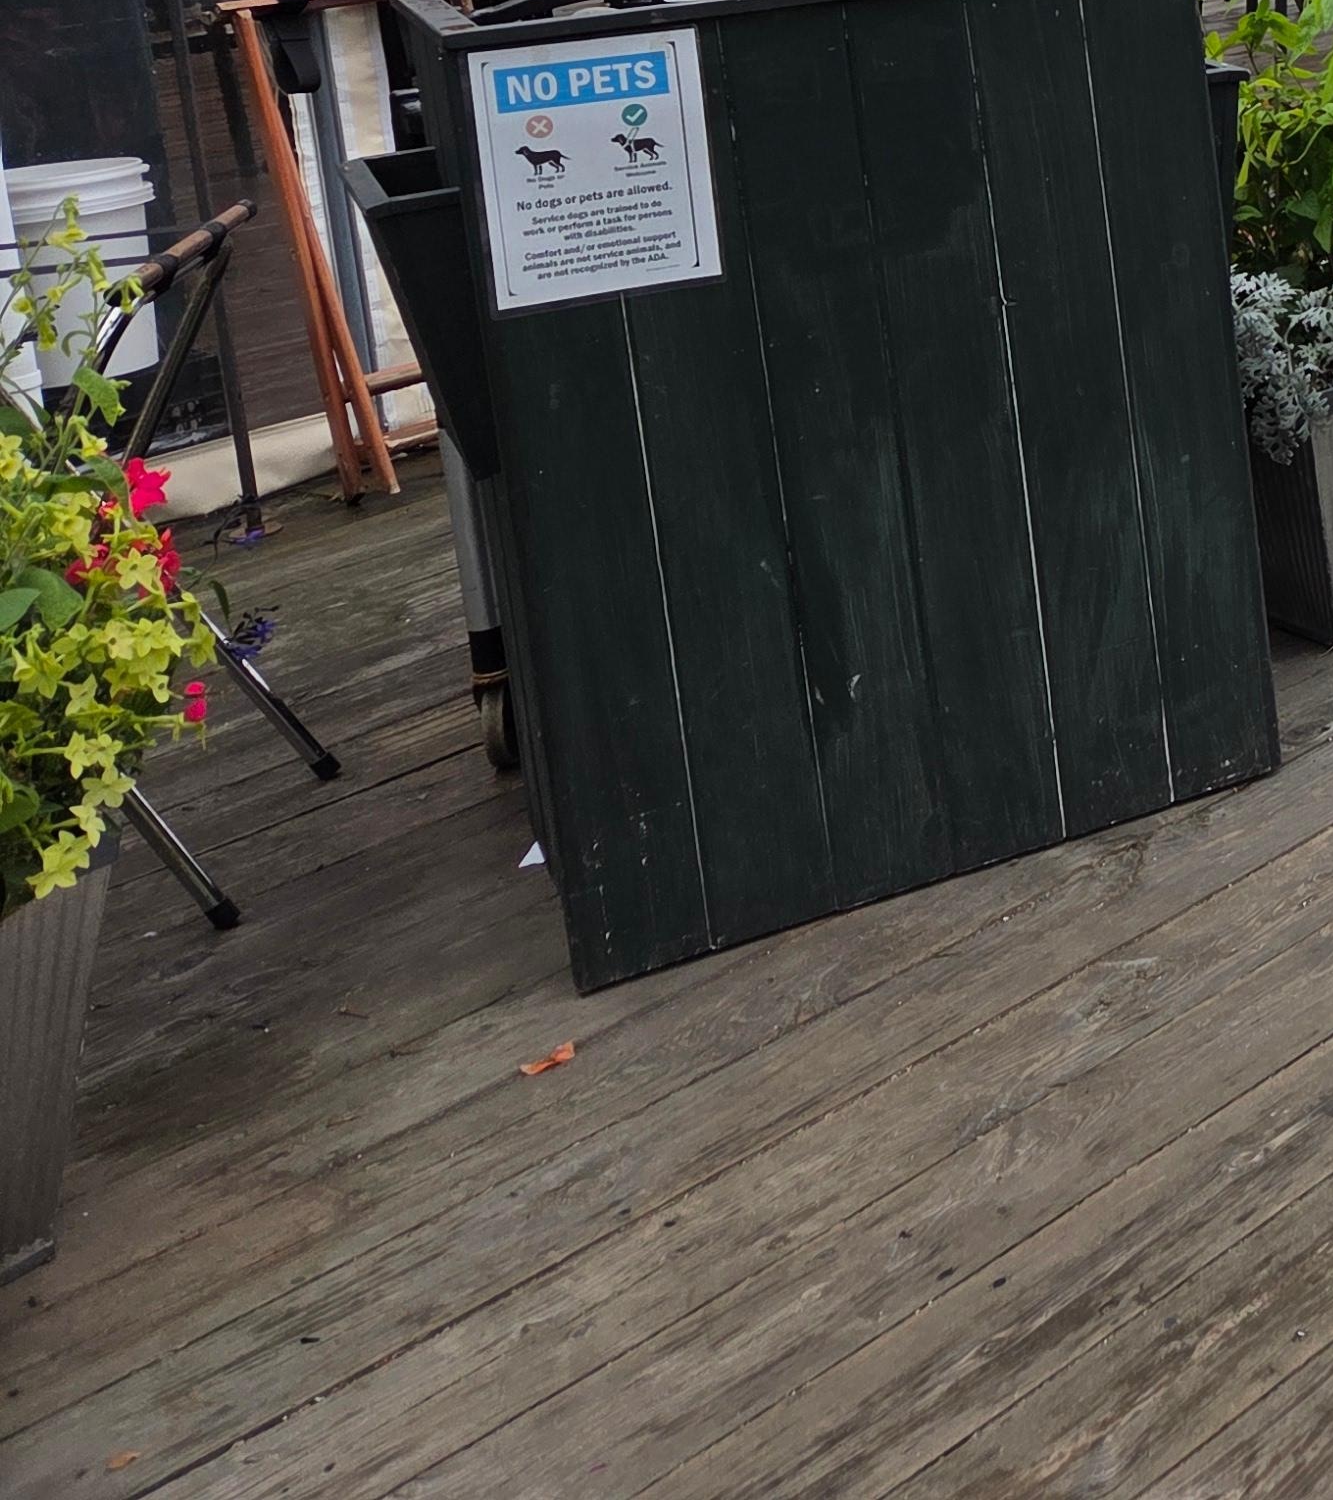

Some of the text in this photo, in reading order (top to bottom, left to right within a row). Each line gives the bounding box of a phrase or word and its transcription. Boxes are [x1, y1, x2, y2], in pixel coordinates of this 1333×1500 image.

[507, 61, 656, 105] NO PETS
[517, 181, 672, 212] No dogs or pets are allowed.
[523, 228, 545, 236] work
[558, 221, 593, 233] perform
[603, 216, 622, 225] task
[638, 209, 672, 221] persons
[532, 215, 565, 225] Service
[567, 211, 589, 220] dogs
[591, 209, 605, 217] are
[607, 203, 638, 214] trained
[524, 231, 676, 261] Comfort and/or emotional support
[564, 225, 636, 241] with disabilities.
[523, 261, 558, 271] animals
[576, 254, 591, 263] not
[593, 250, 624, 260] service
[626, 245, 663, 256] animals,
[665, 241, 681, 249] and
[538, 253, 669, 280] are not recognized by the ADA.
